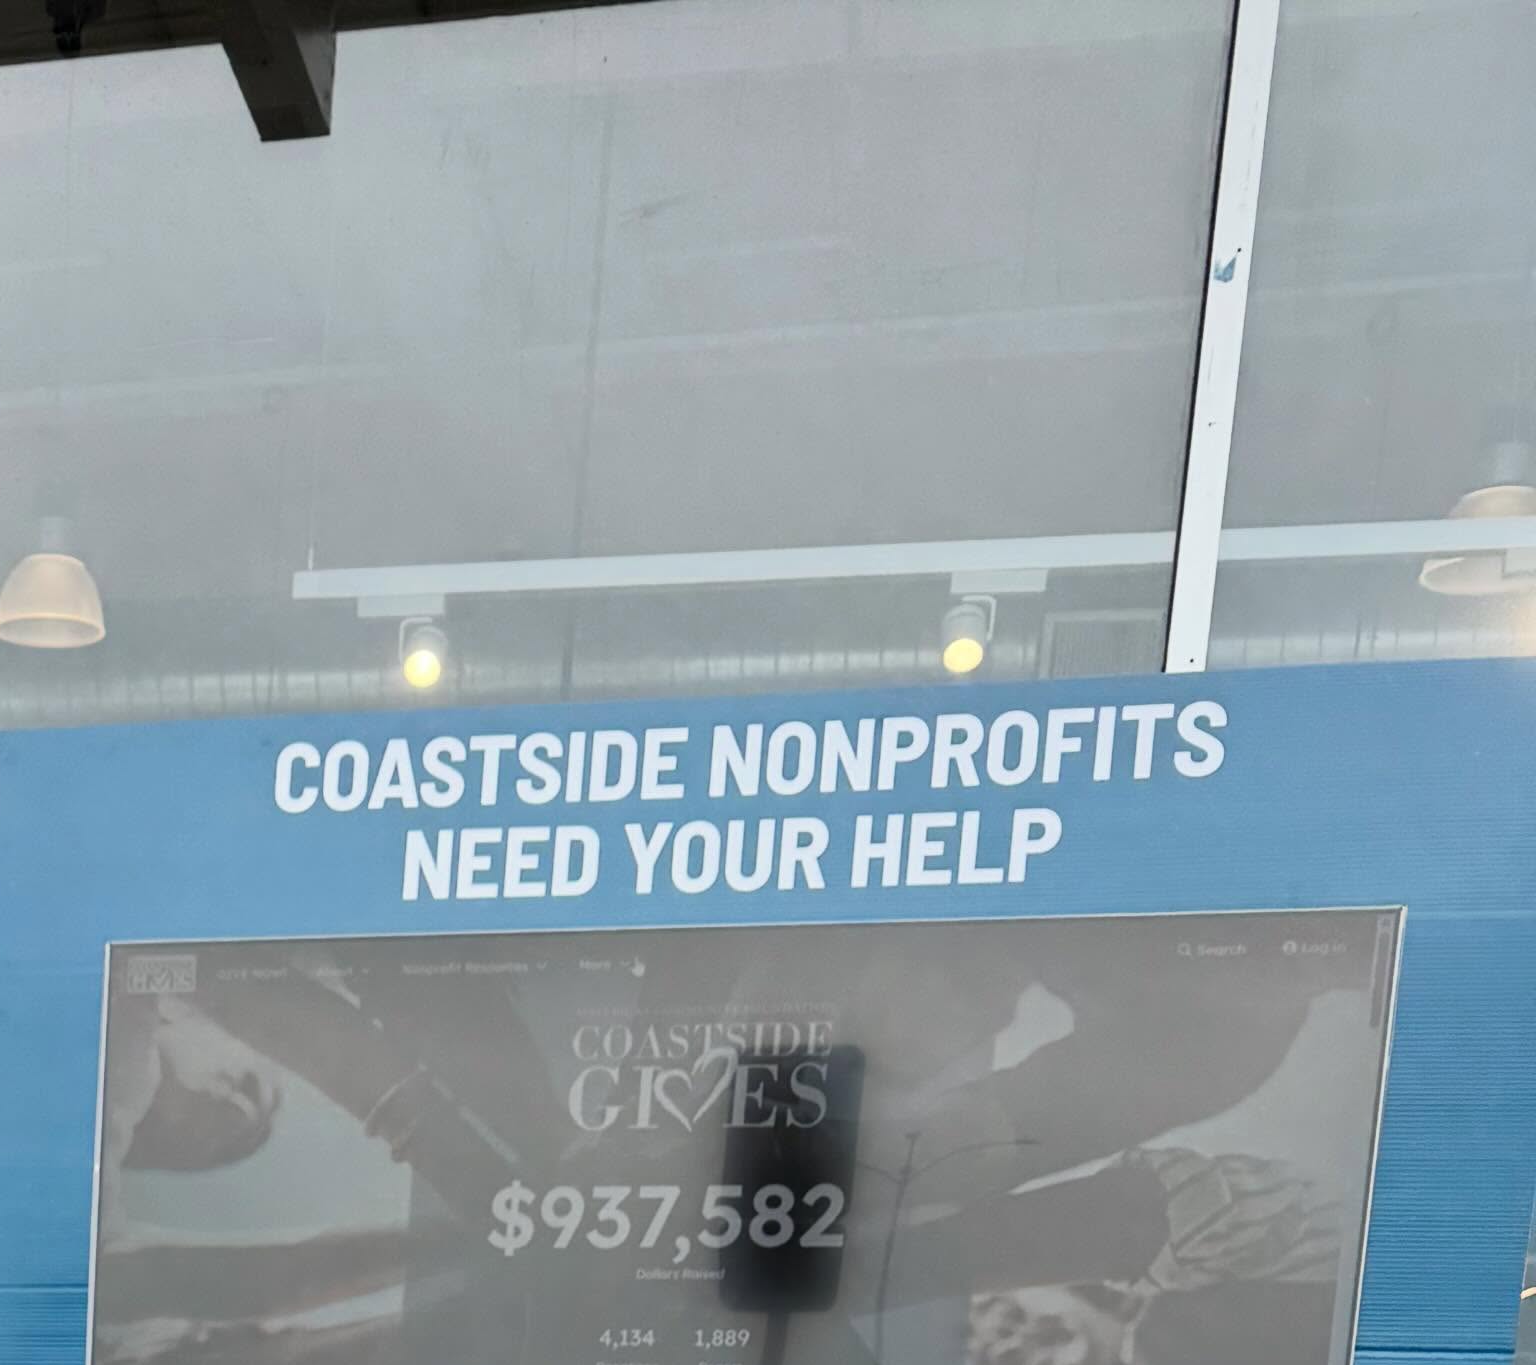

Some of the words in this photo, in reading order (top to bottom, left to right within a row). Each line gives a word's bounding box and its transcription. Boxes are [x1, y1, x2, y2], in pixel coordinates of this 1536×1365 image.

[274, 725, 689, 815] COASTSIDE
[707, 699, 1229, 798] NONPROFITS
[401, 823, 600, 901] NEED
[625, 813, 827, 895] YOUR
[851, 807, 1065, 888] HELP
[1197, 943, 1247, 957] Search
[572, 1021, 833, 1061] COASTSIDE
[487, 1180, 845, 1264] $937,582
[599, 1328, 655, 1351] 4,134
[694, 1328, 751, 1350] 1,889
